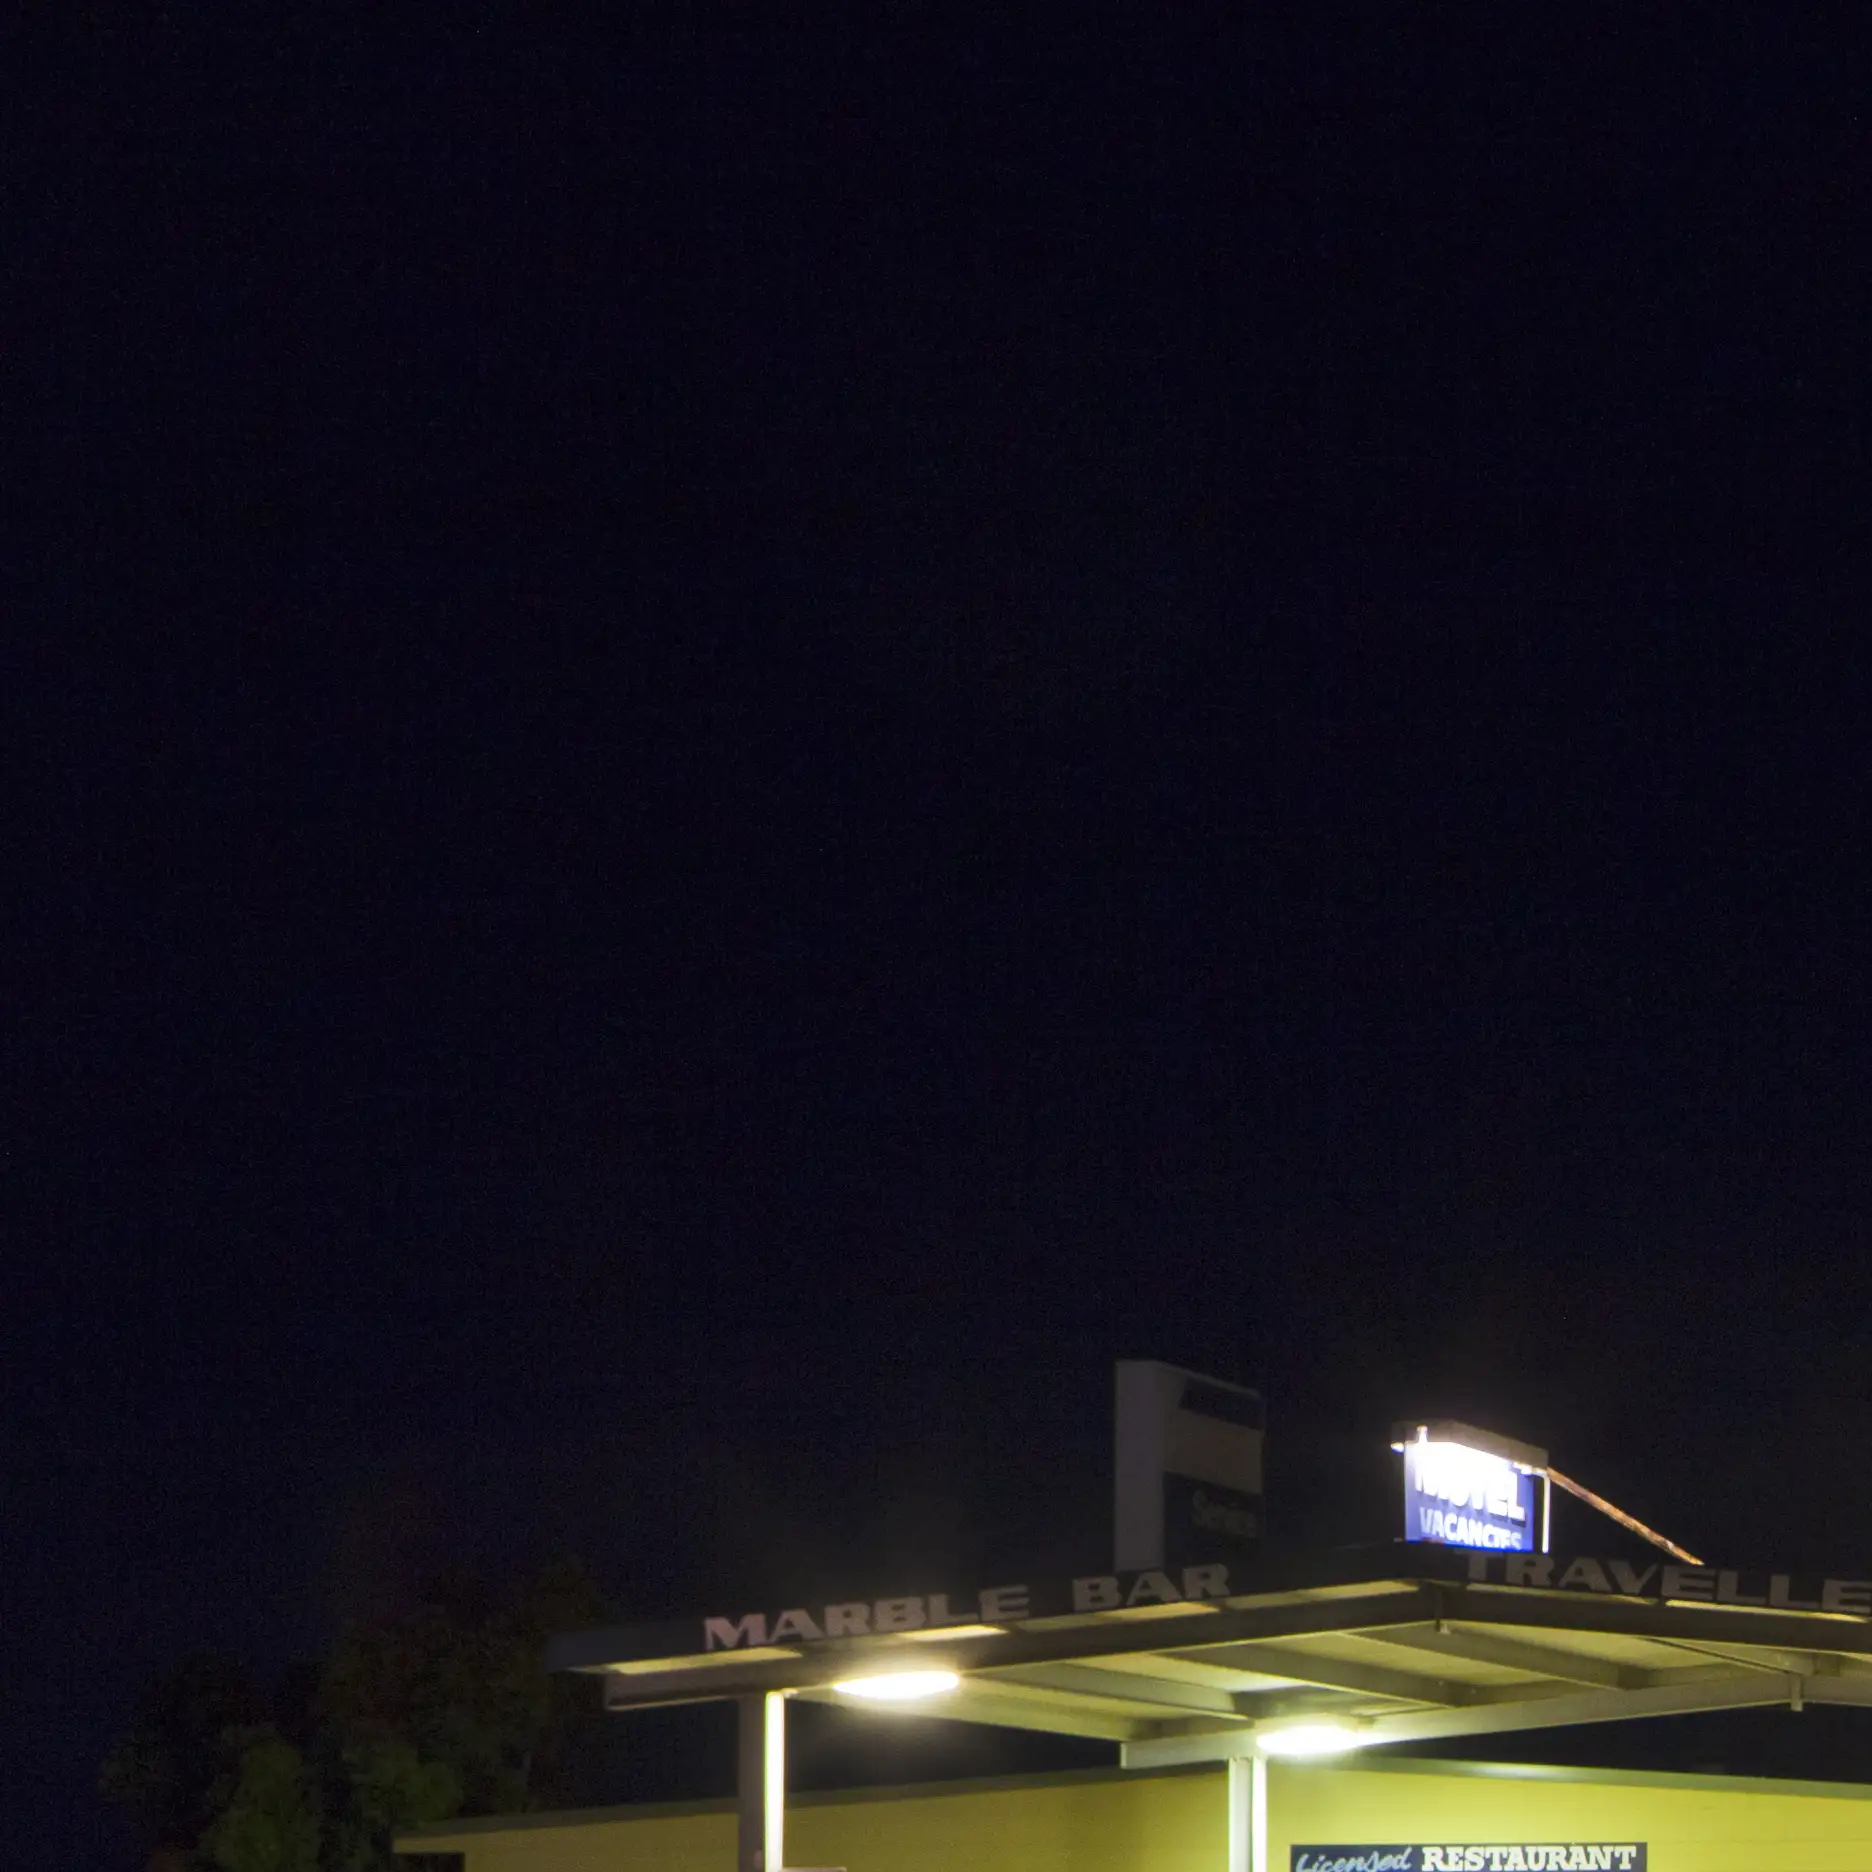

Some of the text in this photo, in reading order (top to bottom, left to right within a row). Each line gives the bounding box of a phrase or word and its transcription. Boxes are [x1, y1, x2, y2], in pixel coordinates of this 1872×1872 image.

[703, 1563, 1231, 1651] MARBLE BAR
[1421, 1845, 1637, 1872] RESTAURANT
